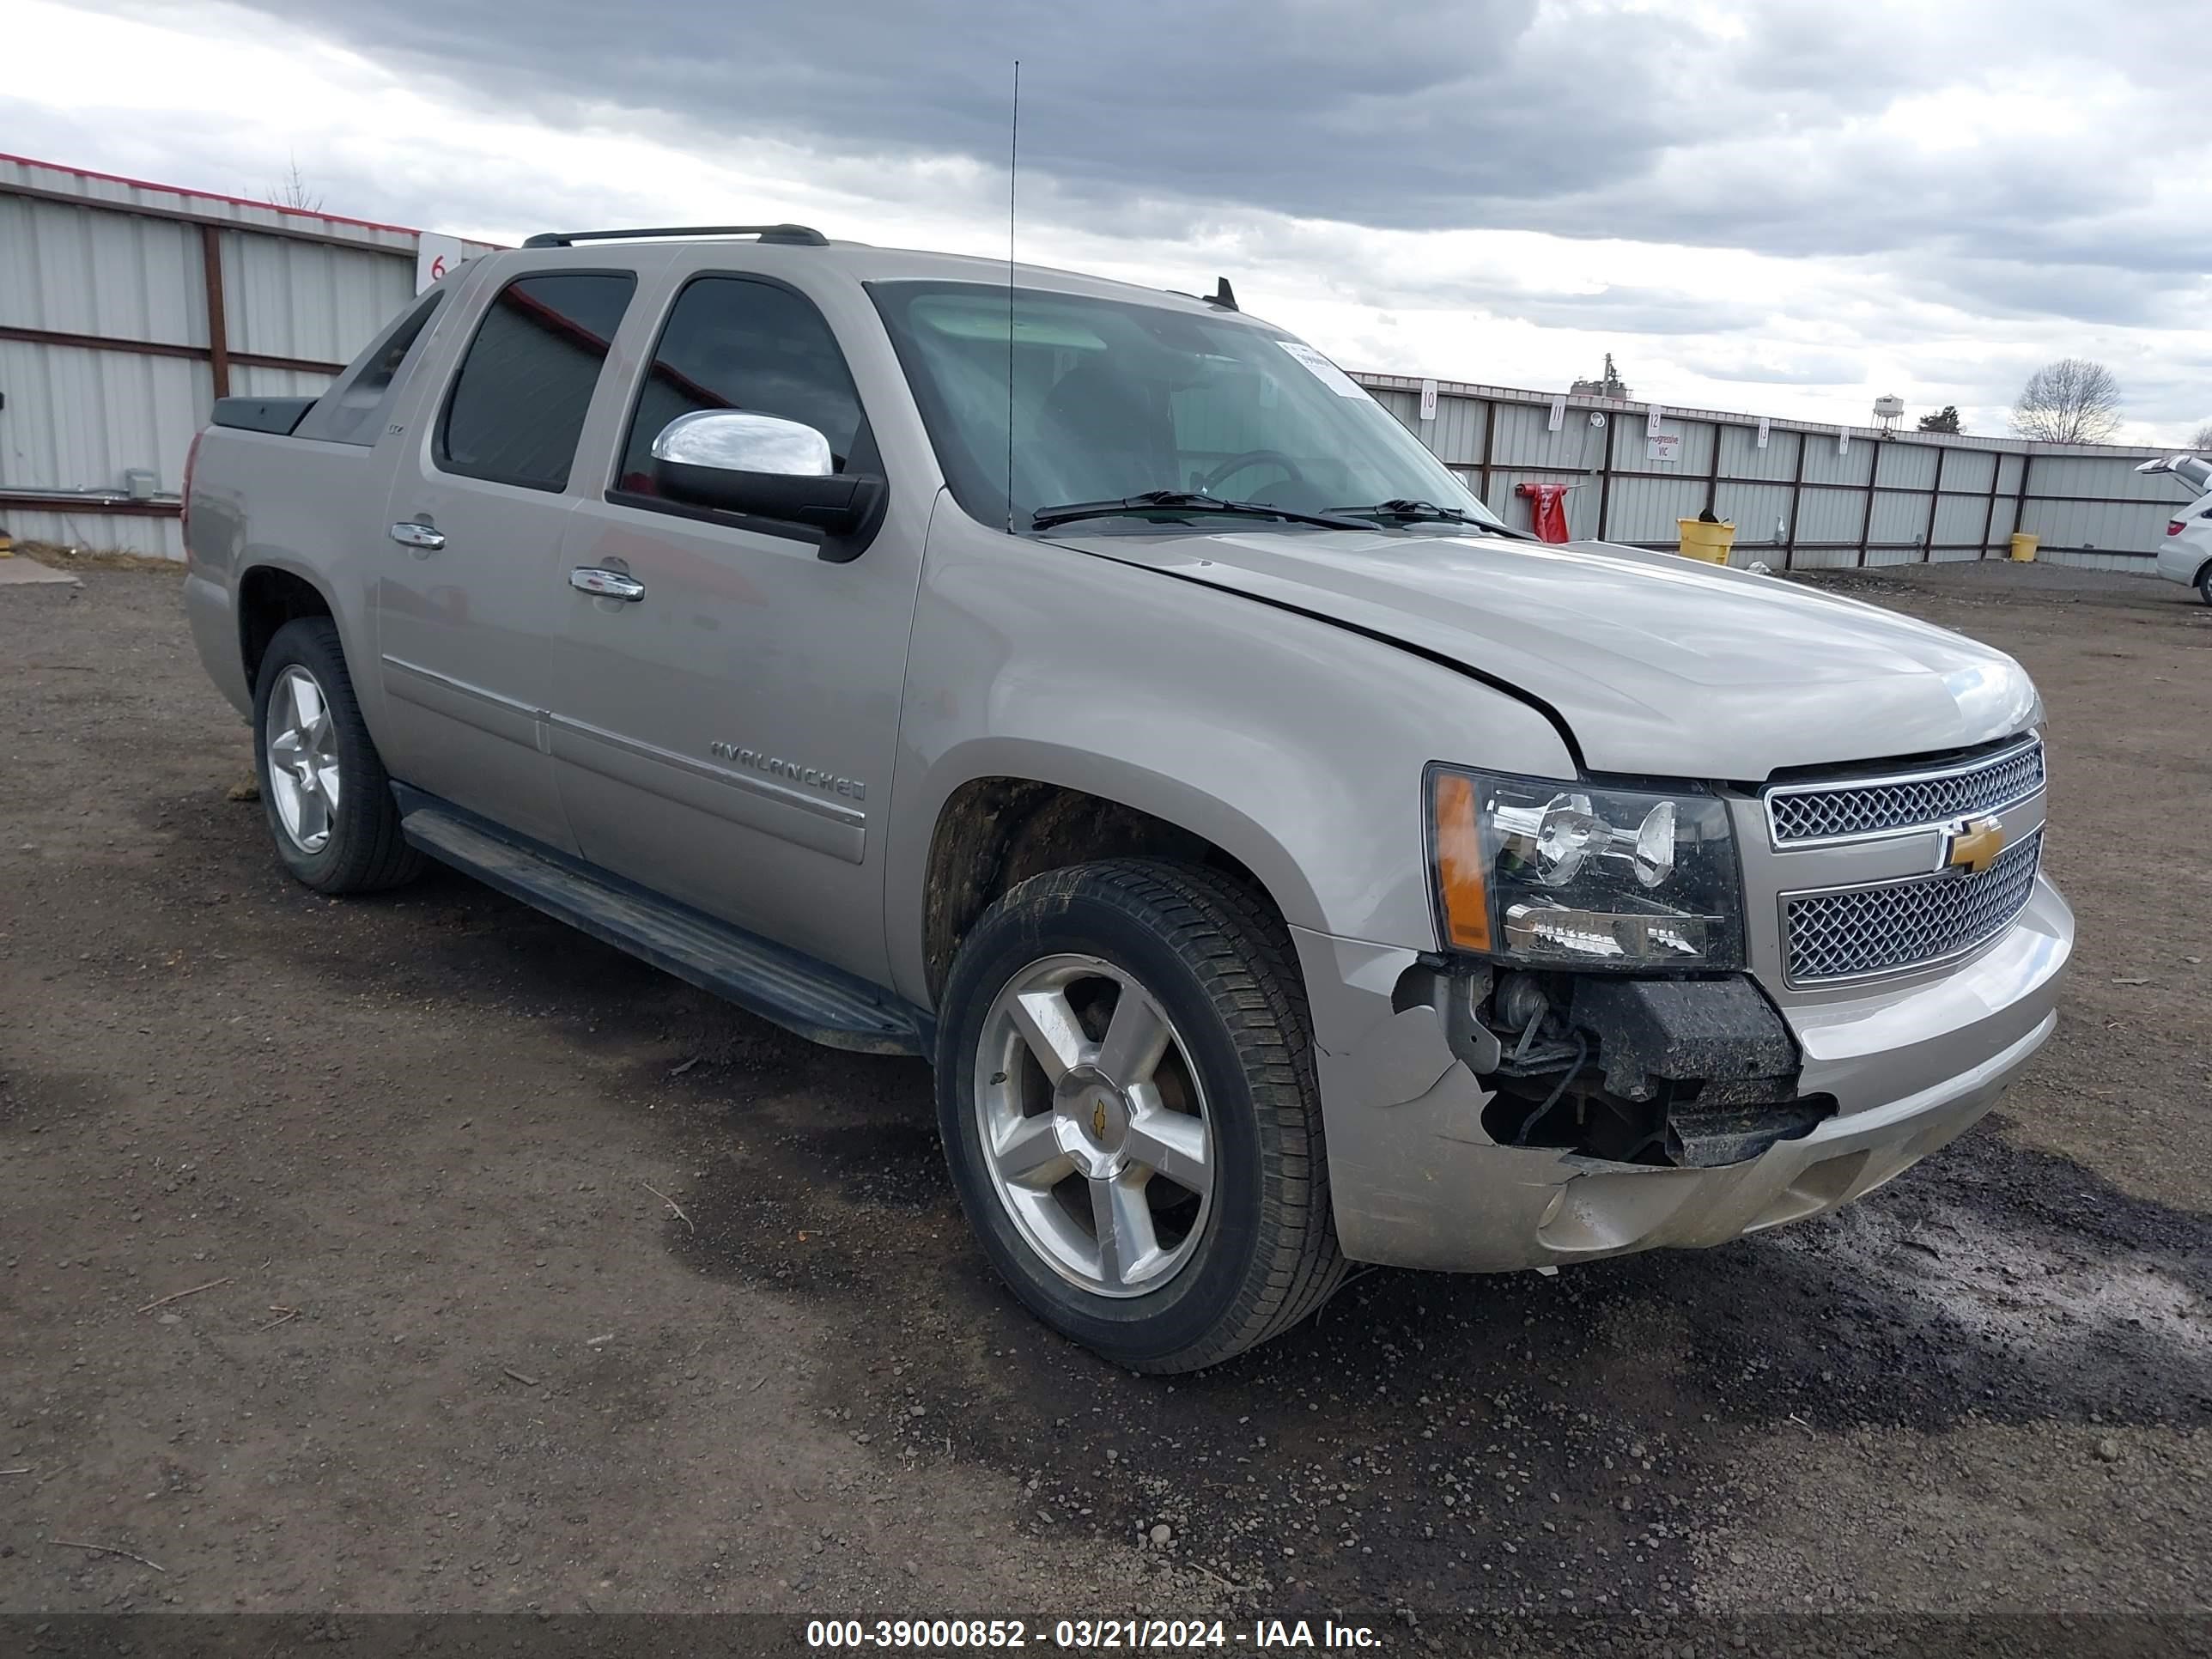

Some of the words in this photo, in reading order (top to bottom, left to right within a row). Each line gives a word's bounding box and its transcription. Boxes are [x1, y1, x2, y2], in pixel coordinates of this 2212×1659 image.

[431, 254, 446, 281] 6
[1423, 392, 1435, 409] 10
[1553, 405, 1562, 421] 11
[1650, 414, 1659, 428] 12
[1759, 426, 1767, 440] 13
[1658, 447, 1668, 457] VIC
[710, 740, 851, 797] AVALANCHE
